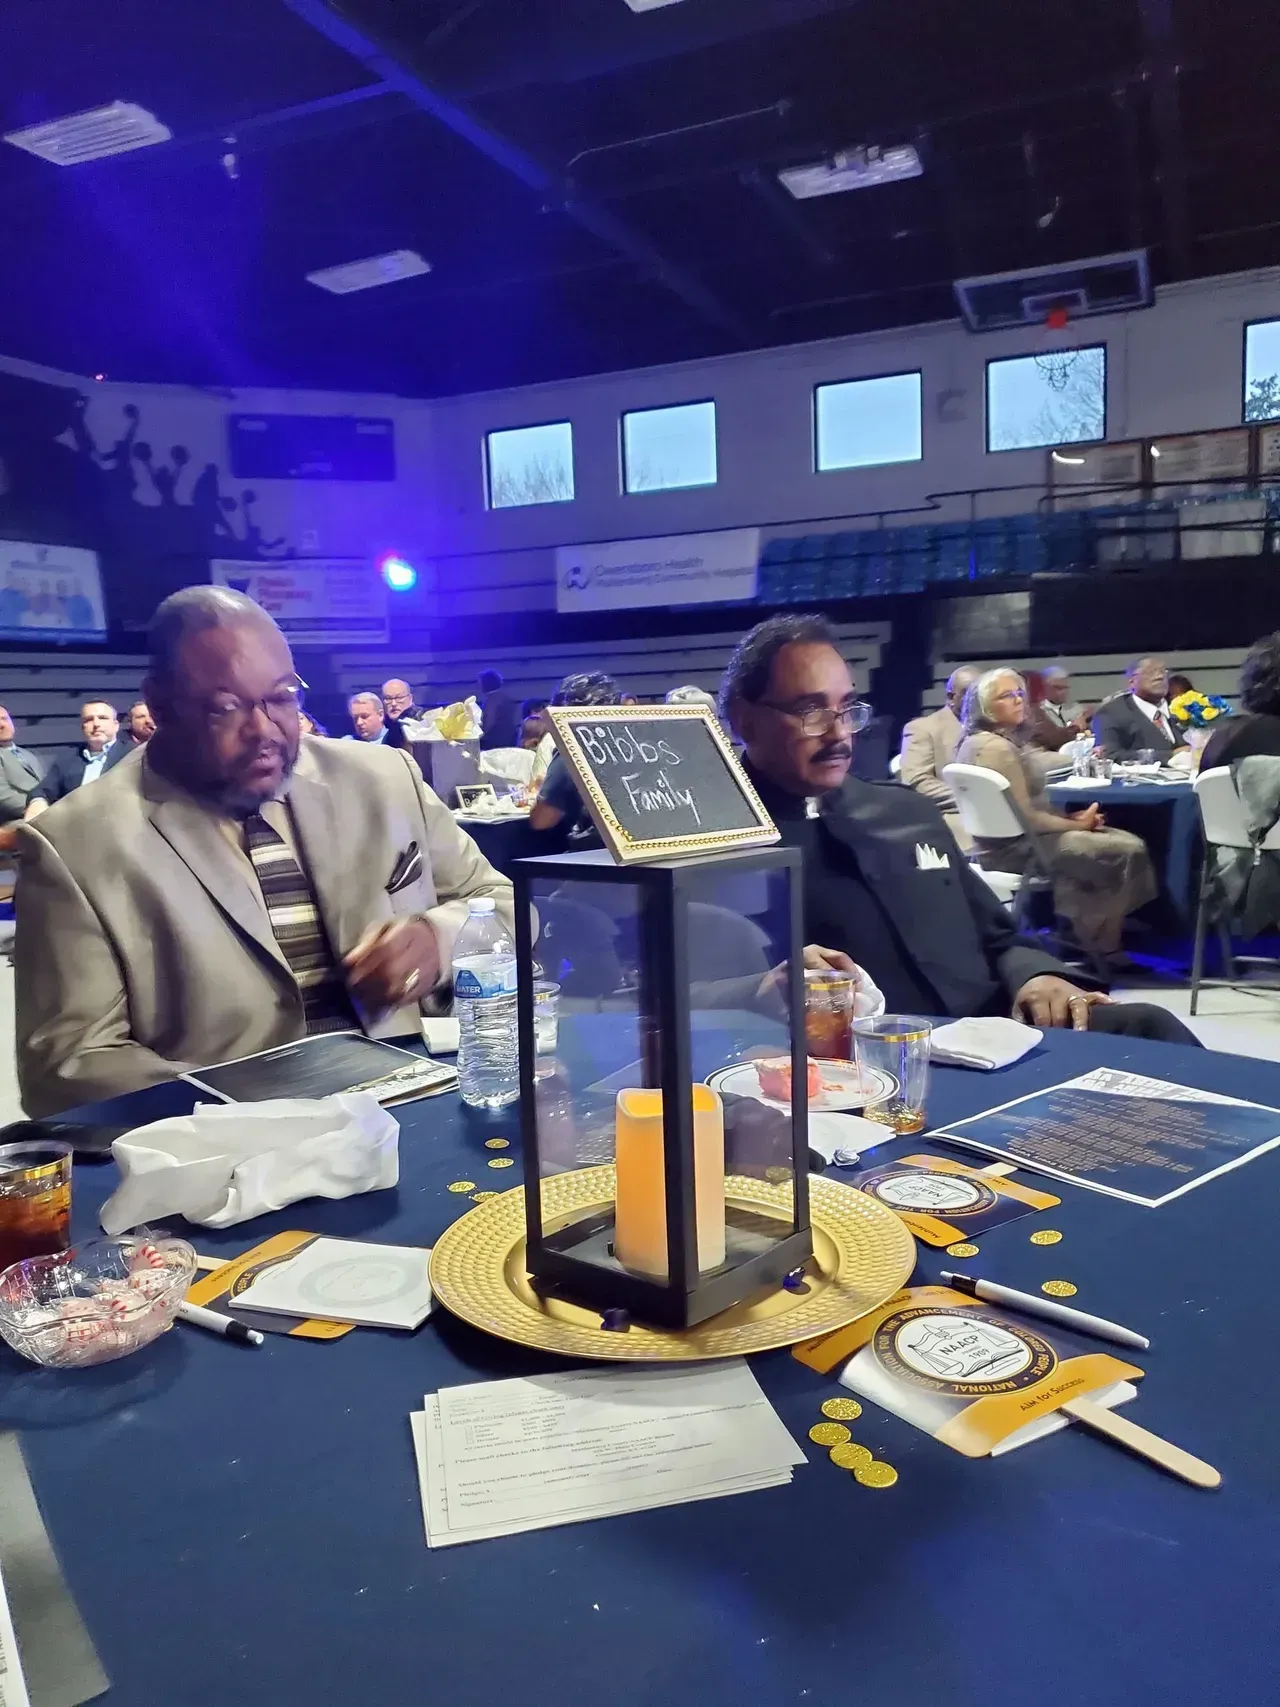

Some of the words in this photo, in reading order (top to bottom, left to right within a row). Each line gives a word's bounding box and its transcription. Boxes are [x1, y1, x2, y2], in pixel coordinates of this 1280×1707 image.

[576, 725, 684, 766] Bibbs
[620, 769, 702, 827] Family
[456, 985, 481, 993] WATER
[909, 1185, 943, 1198] NAACP
[900, 1308, 983, 1321] ADVANCEMENT
[988, 1319, 1005, 1327] OF
[884, 1319, 900, 1332] THE
[879, 1334, 890, 1351] FOR
[939, 1335, 980, 1356] NAACP
[1008, 1326, 1047, 1353] COLORED
[967, 1347, 990, 1361] 1909
[882, 1350, 945, 1390] ASSOCIATION
[1029, 1352, 1050, 1377] PEOPLE
[952, 1380, 1017, 1394] NATIONAL
[1036, 1389, 1052, 1404] for
[1051, 1376, 1086, 1397] Success
